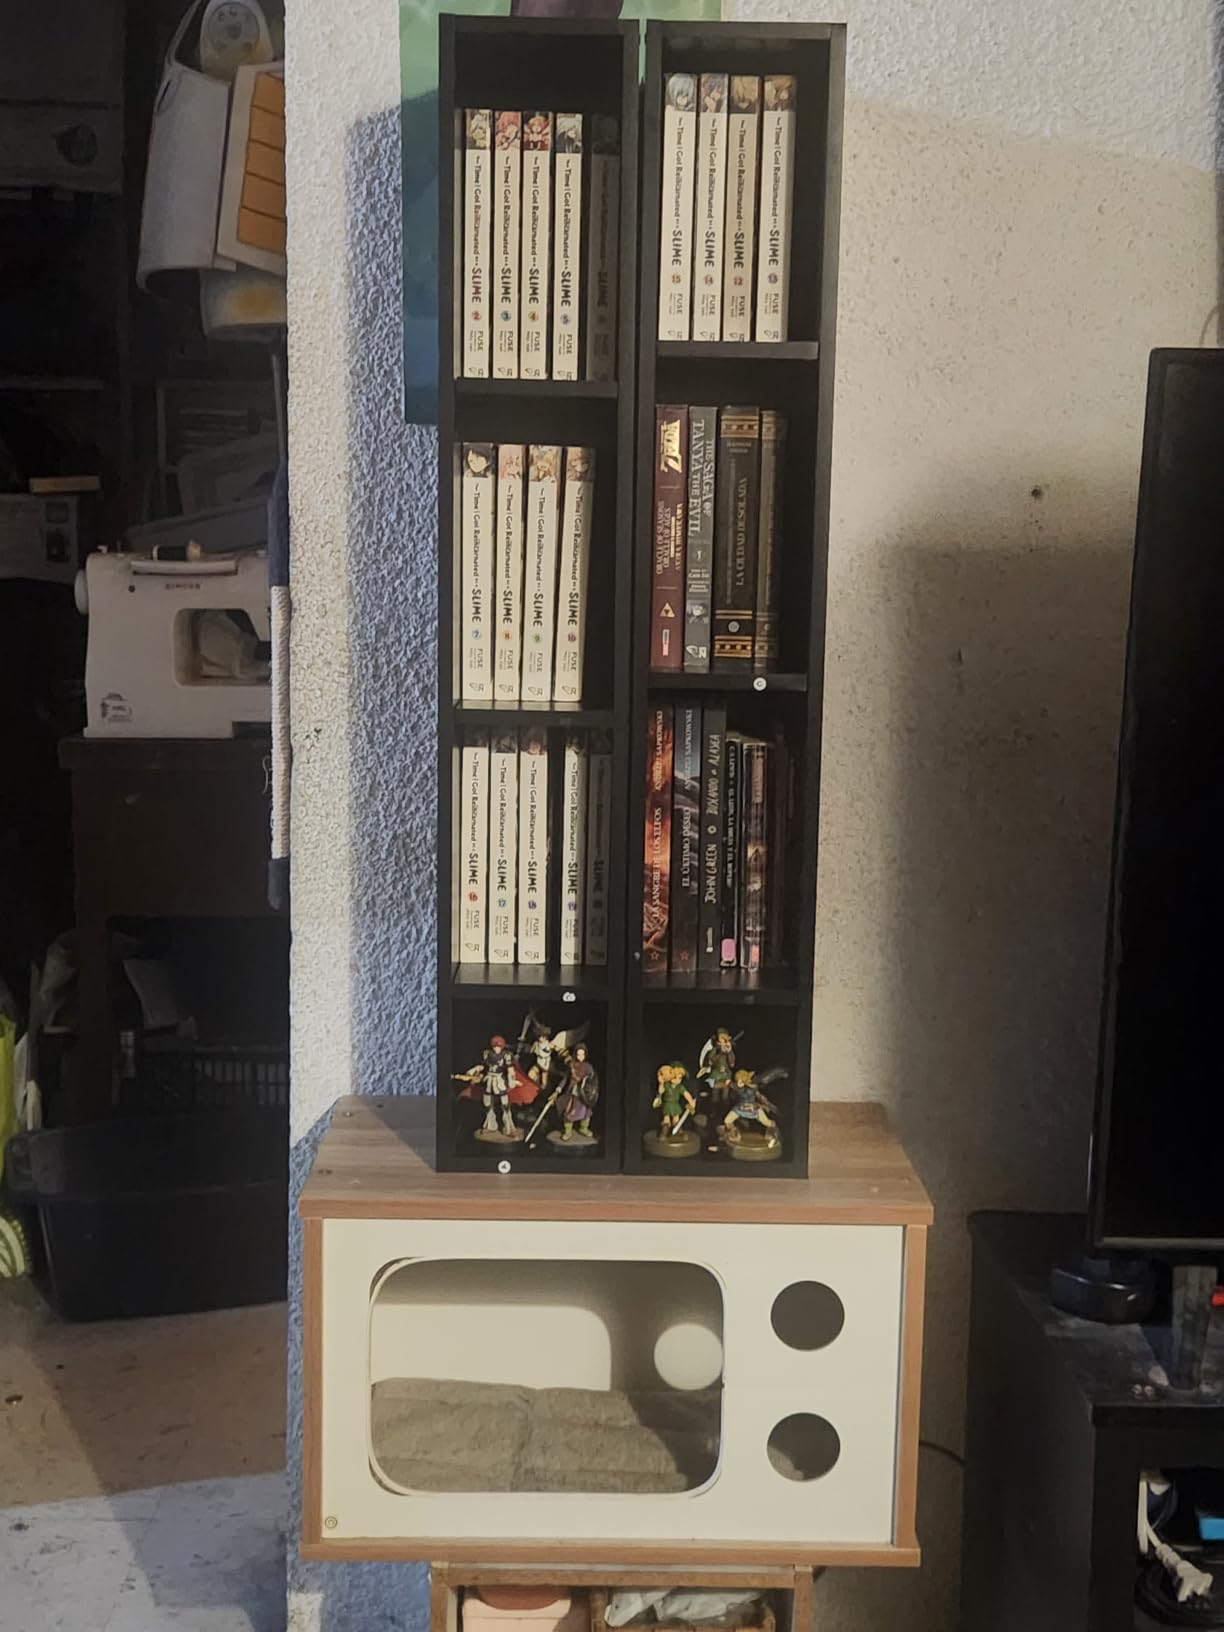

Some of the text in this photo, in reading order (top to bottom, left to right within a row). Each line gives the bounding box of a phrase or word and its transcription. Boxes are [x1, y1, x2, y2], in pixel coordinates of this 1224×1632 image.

[672, 231, 682, 266] SLIME
[705, 232, 714, 268] SLIME
[734, 233, 743, 269] SLIME
[769, 230, 779, 266] SLIME
[472, 268, 481, 303] SLIME
[502, 268, 511, 303] SLIME
[529, 268, 539, 304] SLIME
[561, 271, 571, 306] SLIME
[676, 294, 684, 315] FUSE
[738, 296, 746, 317] FUSE
[476, 331, 484, 352] FUSE
[533, 331, 541, 352] FUSE
[688, 419, 704, 536] TANYA THE EVIL
[703, 441, 714, 517] THE SAGA OF
[737, 478, 747, 531] DESOLADA
[736, 533, 745, 570] CIUDAD
[472, 589, 481, 623] SLIME
[503, 591, 512, 624] SLIME
[533, 593, 543, 626] SLIME
[568, 593, 577, 626] SLIME
[476, 649, 484, 668] FUSE
[570, 652, 578, 671] FUSE
[469, 854, 478, 885] SLIME
[498, 860, 507, 891] SLIME
[527, 861, 537, 893] SLIME
[568, 863, 577, 894] SLIME
[704, 844, 717, 904] JOHN GREEN
[652, 868, 661, 905] SANGRE
[532, 918, 540, 936] FUSE
[572, 919, 580, 938] FUSE
